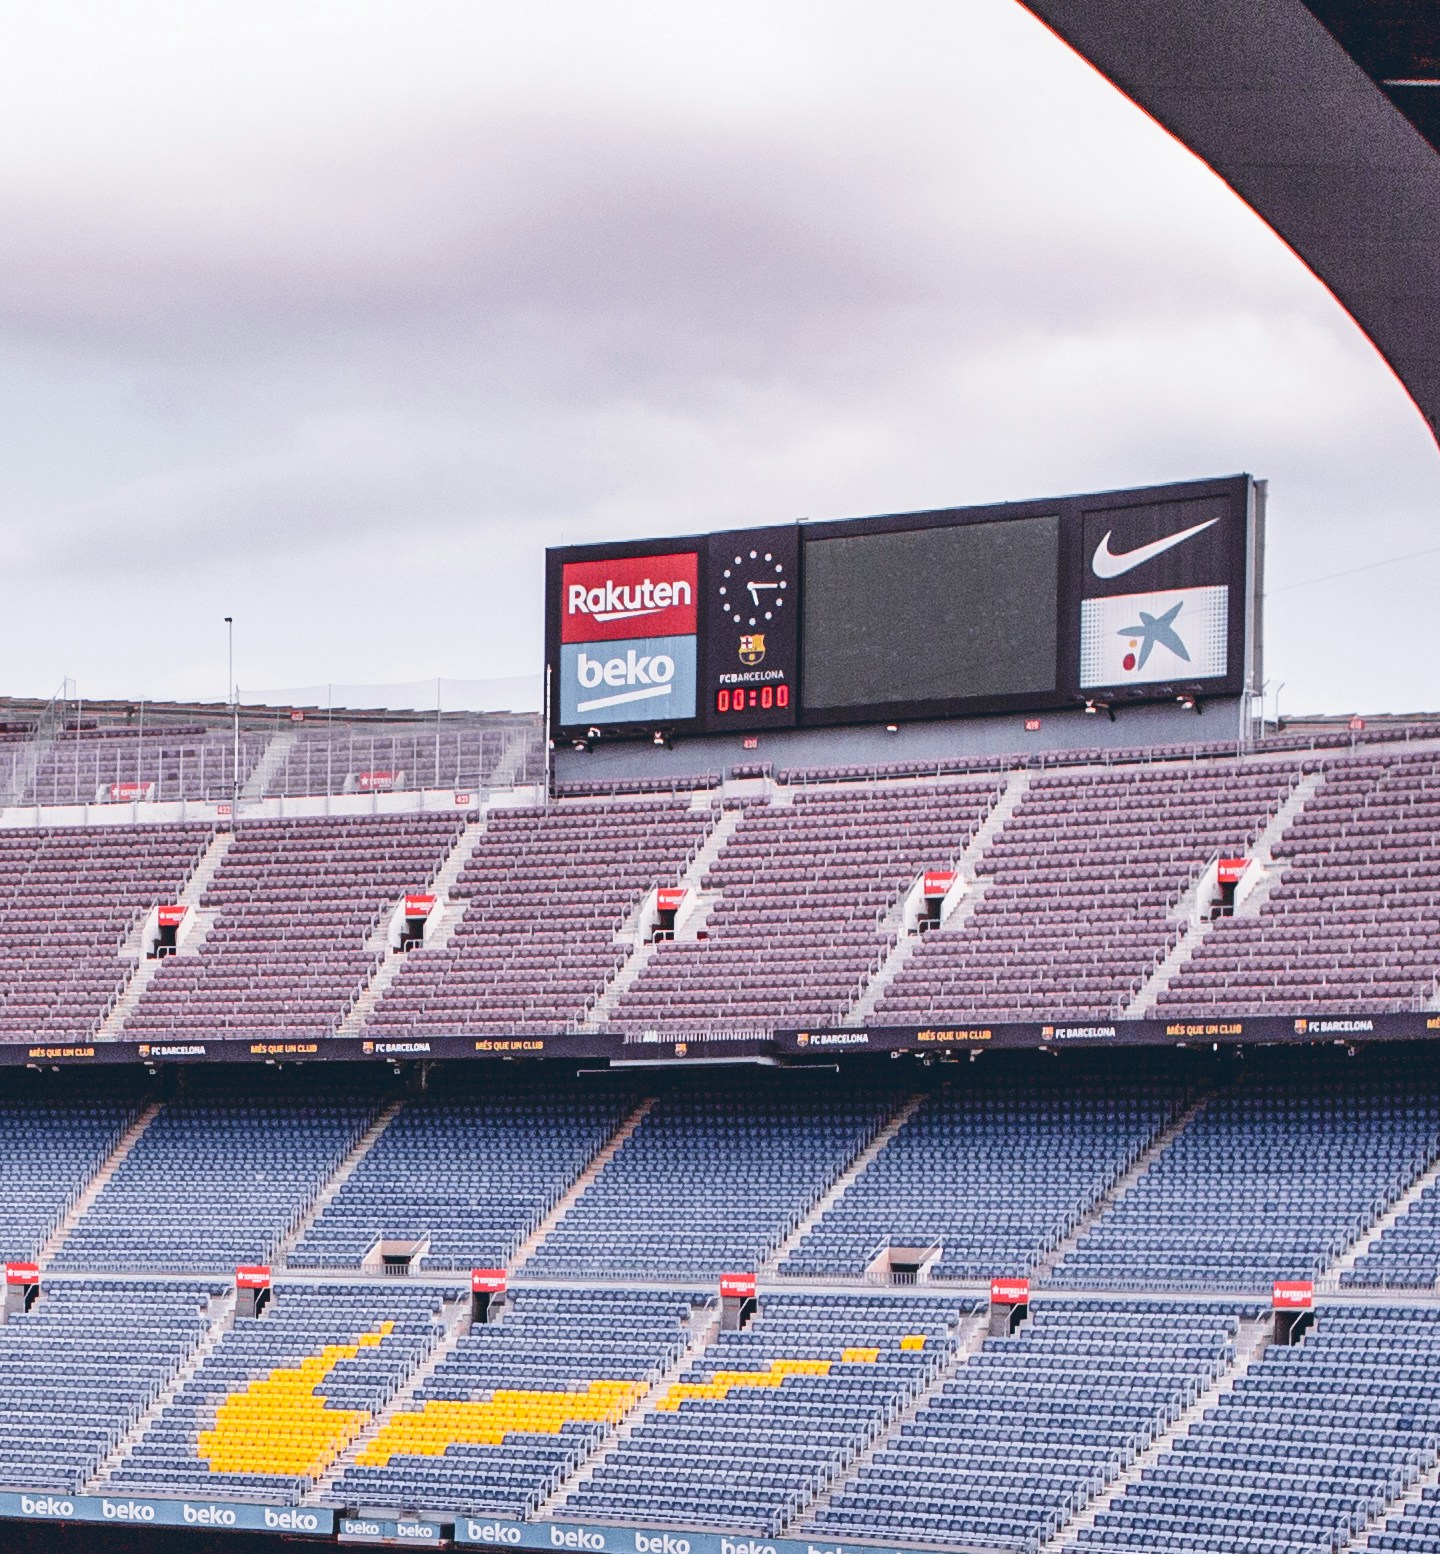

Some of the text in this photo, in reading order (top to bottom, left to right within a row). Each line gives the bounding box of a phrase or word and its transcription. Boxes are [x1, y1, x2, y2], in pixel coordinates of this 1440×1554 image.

[569, 578, 690, 614] Rakuten
[578, 650, 675, 688] beko
[717, 684, 789, 712] 00:00
[1053, 1026, 1115, 1038] FC BARCELONA
[1167, 1024, 1185, 1035] MÉS
[1187, 1026, 1204, 1036] QUE
[1221, 1023, 1242, 1034] CLUB
[1309, 1019, 1373, 1032] FC BARCELONA
[811, 1034, 868, 1045] FC BARCELONA
[918, 1030, 936, 1040] MÉS
[938, 1032, 954, 1041] QUE
[971, 1030, 991, 1039] CLUB
[29, 1048, 45, 1057] MÉS
[46, 1049, 61, 1058] QUE
[76, 1047, 94, 1056] CLUB
[151, 1046, 205, 1055] FC BARCELONA
[251, 1044, 267, 1053] MÉS
[269, 1045, 283, 1054] QUE
[299, 1044, 317, 1052] CLUB
[375, 1042, 430, 1053] FC BARCELONA
[476, 1040, 492, 1050] MÉS
[494, 1041, 509, 1051] QUE
[524, 1041, 543, 1049] CLUB
[22, 1496, 73, 1516] beko
[103, 1499, 154, 1520] beko
[184, 1504, 235, 1524] beko
[265, 1508, 317, 1530] beko
[345, 1521, 380, 1536] beko
[397, 1523, 433, 1538] beko
[468, 1521, 520, 1543] beko
[551, 1527, 604, 1549] beko
[636, 1533, 690, 1554] beko
